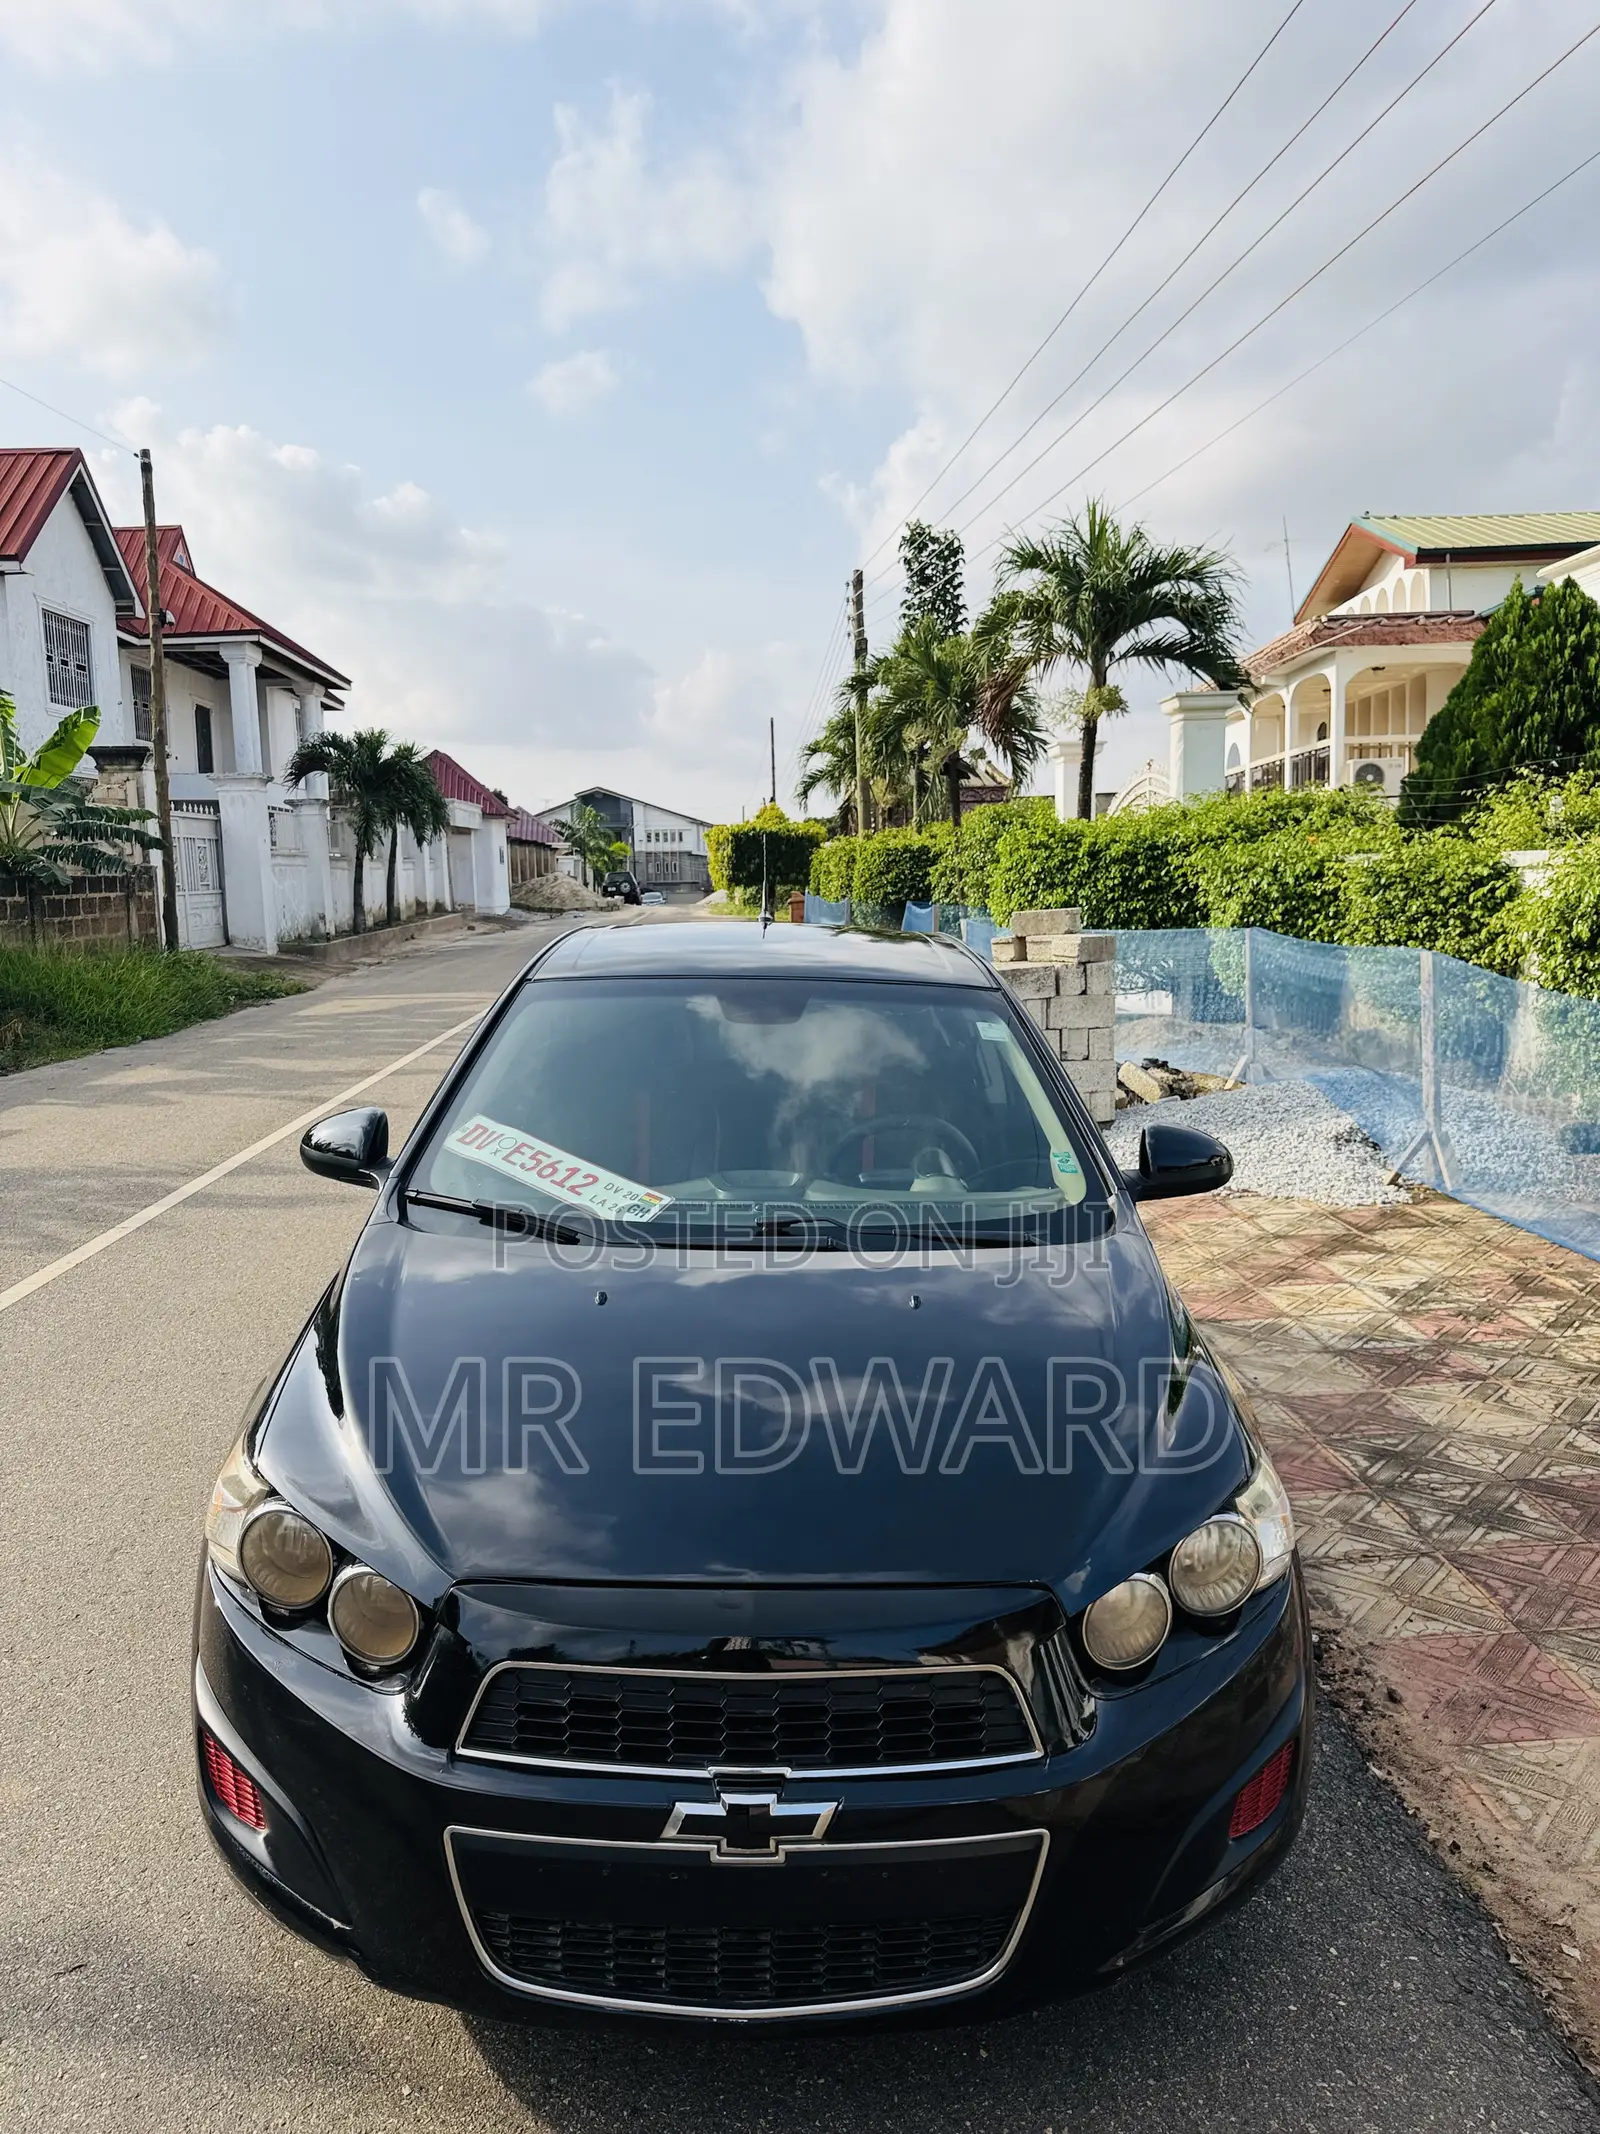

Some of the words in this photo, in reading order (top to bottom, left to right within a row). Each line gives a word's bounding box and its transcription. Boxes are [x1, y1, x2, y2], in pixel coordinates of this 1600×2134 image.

[456, 1123, 505, 1151] DV
[501, 1142, 600, 1196] E5612
[588, 1194, 608, 1208] LA
[603, 1182, 623, 1195] DV
[622, 1190, 640, 1202] 20
[626, 1203, 652, 1219] GH
